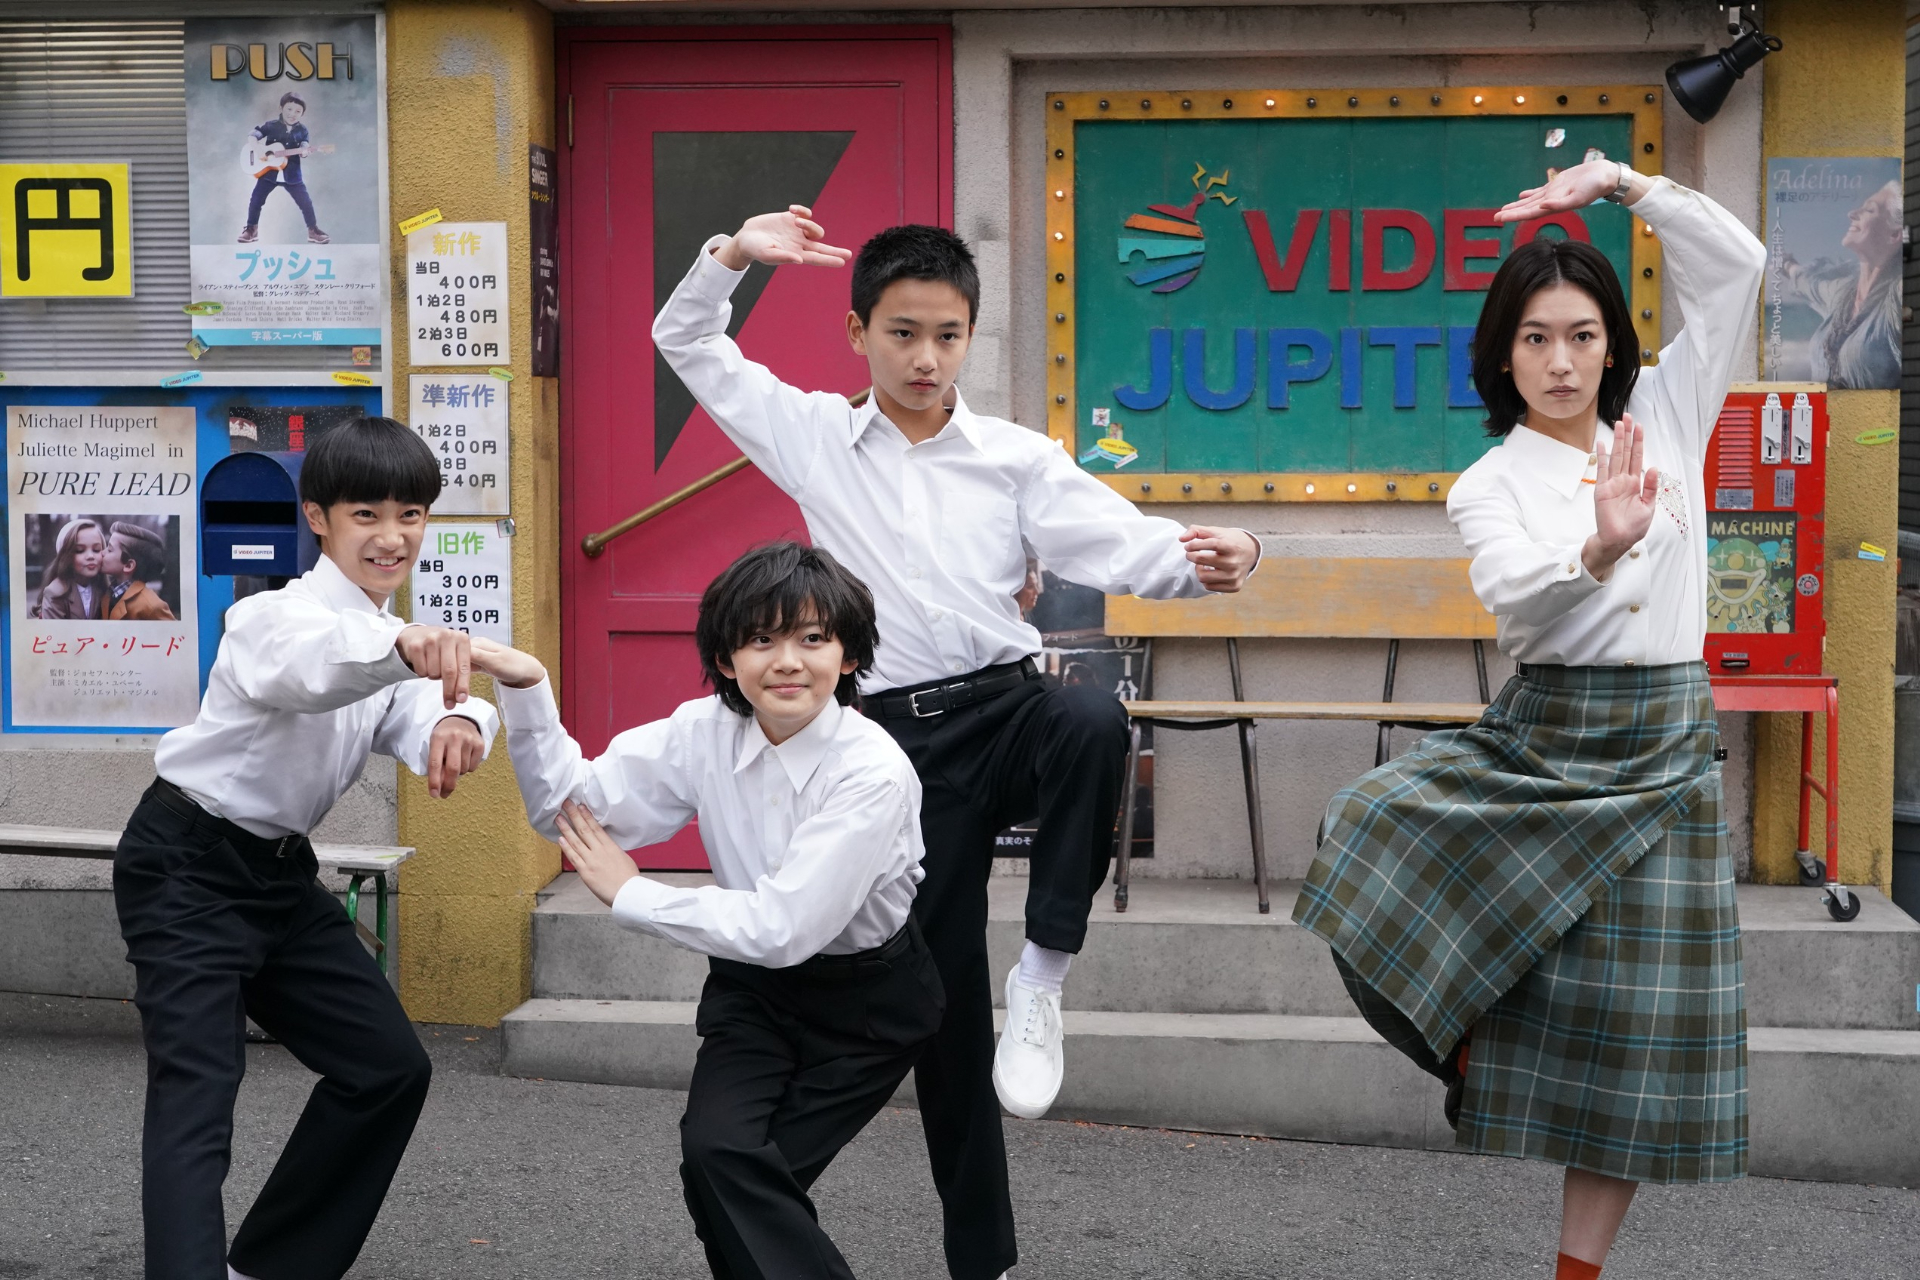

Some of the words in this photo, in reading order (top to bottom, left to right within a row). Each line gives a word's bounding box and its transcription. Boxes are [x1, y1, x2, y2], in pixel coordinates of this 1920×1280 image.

[210, 41, 353, 81] PUSH
[1774, 164, 1862, 190] Adelina
[14, 177, 115, 282] 円
[432, 232, 482, 256] 新作
[235, 249, 336, 282] プッシュ
[415, 261, 440, 274] 当日
[439, 275, 496, 290] 400円
[416, 294, 465, 307] 1泊2日
[440, 309, 497, 324] 480円
[251, 330, 323, 341] 字幕スーパー版
[418, 327, 468, 341] 2泊3日
[441, 342, 499, 357] 600円
[422, 384, 496, 408] 準新作
[18, 414, 83, 428] Michael
[90, 414, 158, 432] Huppert
[418, 424, 466, 437] 1泊2日
[18, 442, 77, 457] Juliette
[84, 442, 155, 461] Magimel
[168, 443, 184, 457] in
[440, 440, 496, 454] 400円
[17, 472, 100, 496] PURE
[107, 472, 192, 496] LEAD
[1711, 521, 1793, 535] MACHINE
[438, 532, 485, 555] 旧作
[420, 560, 444, 572] 当日
[442, 575, 498, 589] 300円
[419, 594, 467, 607] 1泊2日
[443, 610, 499, 623] 350円
[32, 635, 185, 656] ピュア・リード
